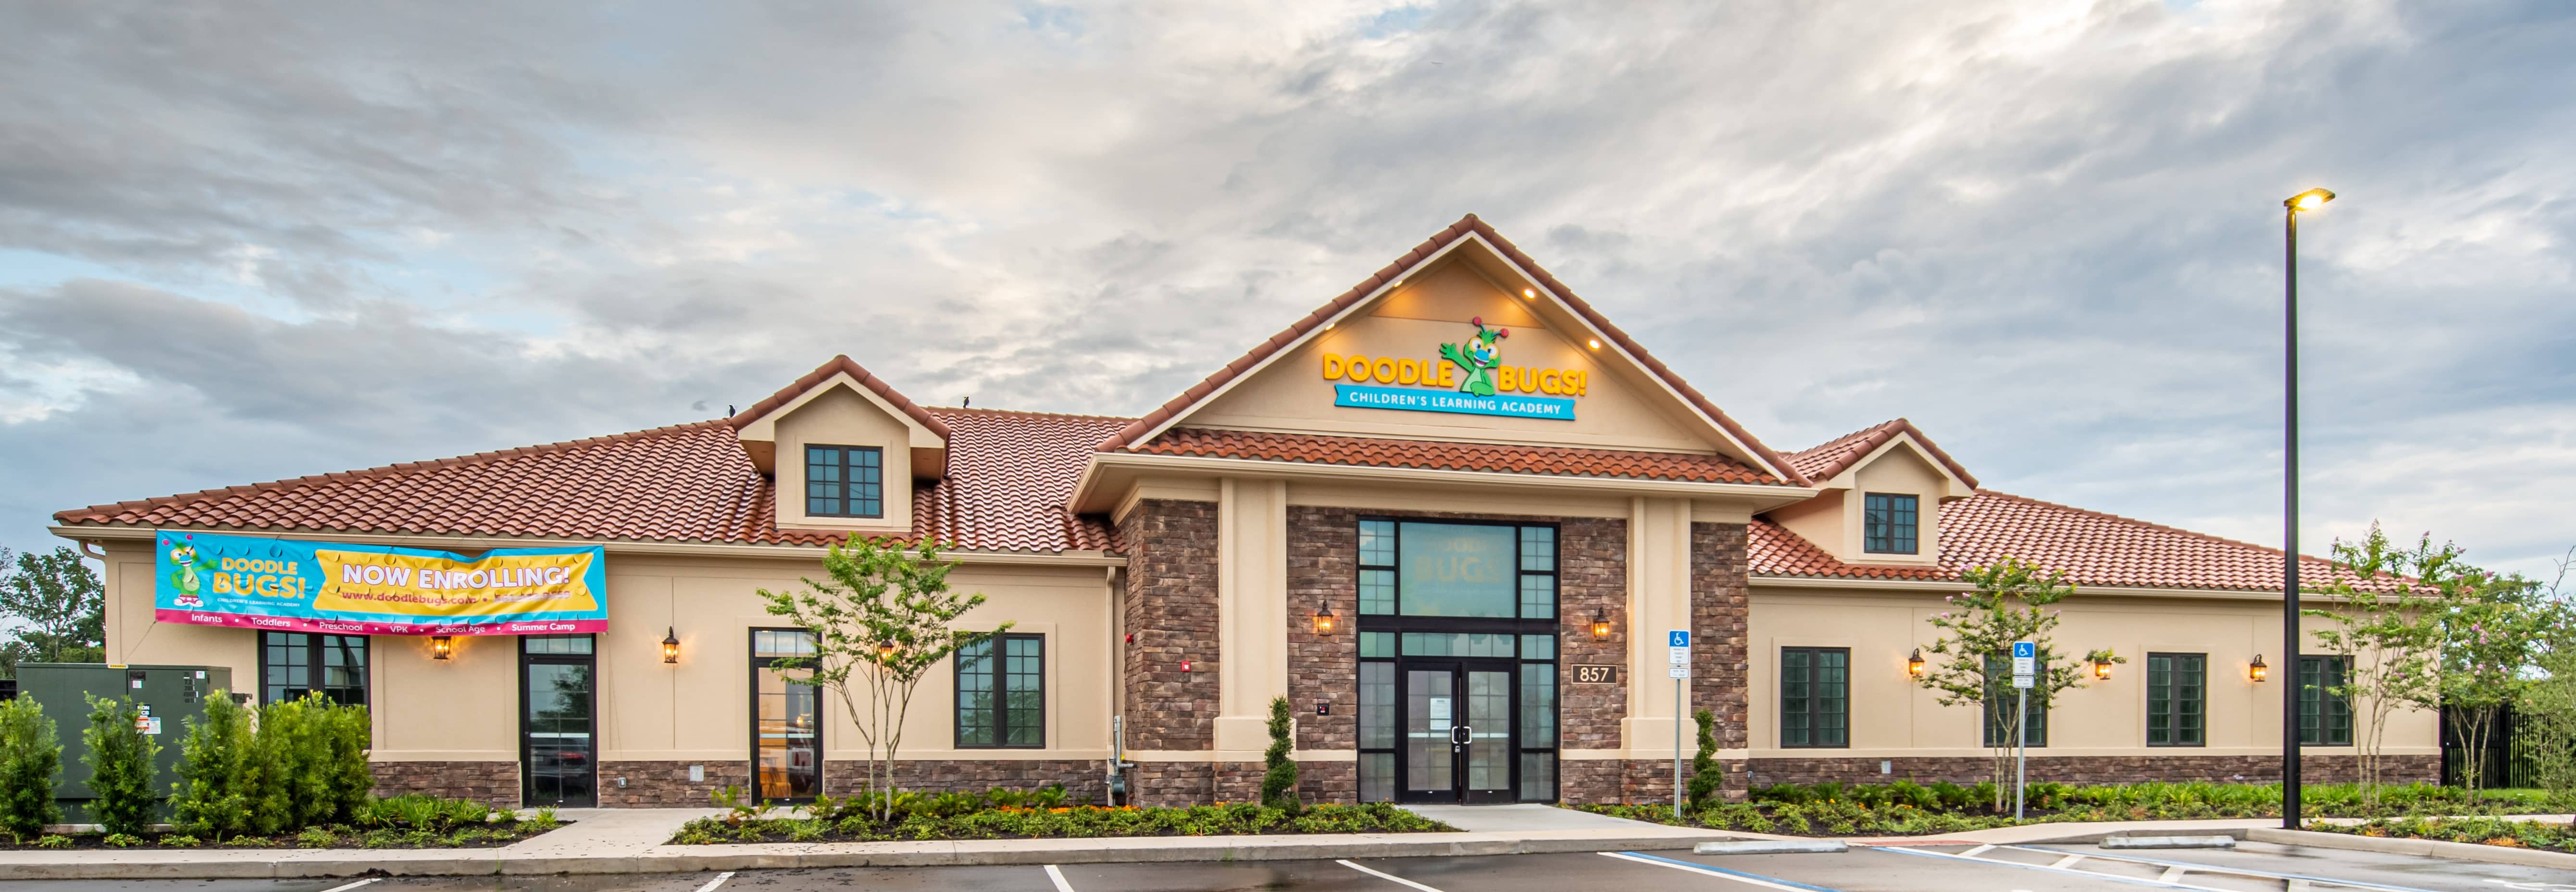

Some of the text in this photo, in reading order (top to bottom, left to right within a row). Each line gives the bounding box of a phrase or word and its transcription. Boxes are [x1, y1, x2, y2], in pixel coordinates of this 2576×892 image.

[1323, 353, 1587, 396] DOODLE BUGS!
[1350, 392, 1561, 414] CHILDREN'S LEARNING ACADEMY
[222, 557, 298, 575] DOODLE
[343, 564, 571, 590] NOW ENROLLING!
[213, 572, 306, 599] BUGS!
[342, 592, 477, 606] www.doodlebugs.com
[192, 614, 223, 623] Infants
[251, 617, 291, 627] Toddlers
[320, 622, 363, 632] Preschool
[469, 626, 485, 634] Age
[512, 623, 575, 632] Summer Camp
[1580, 667, 1609, 682] 857
